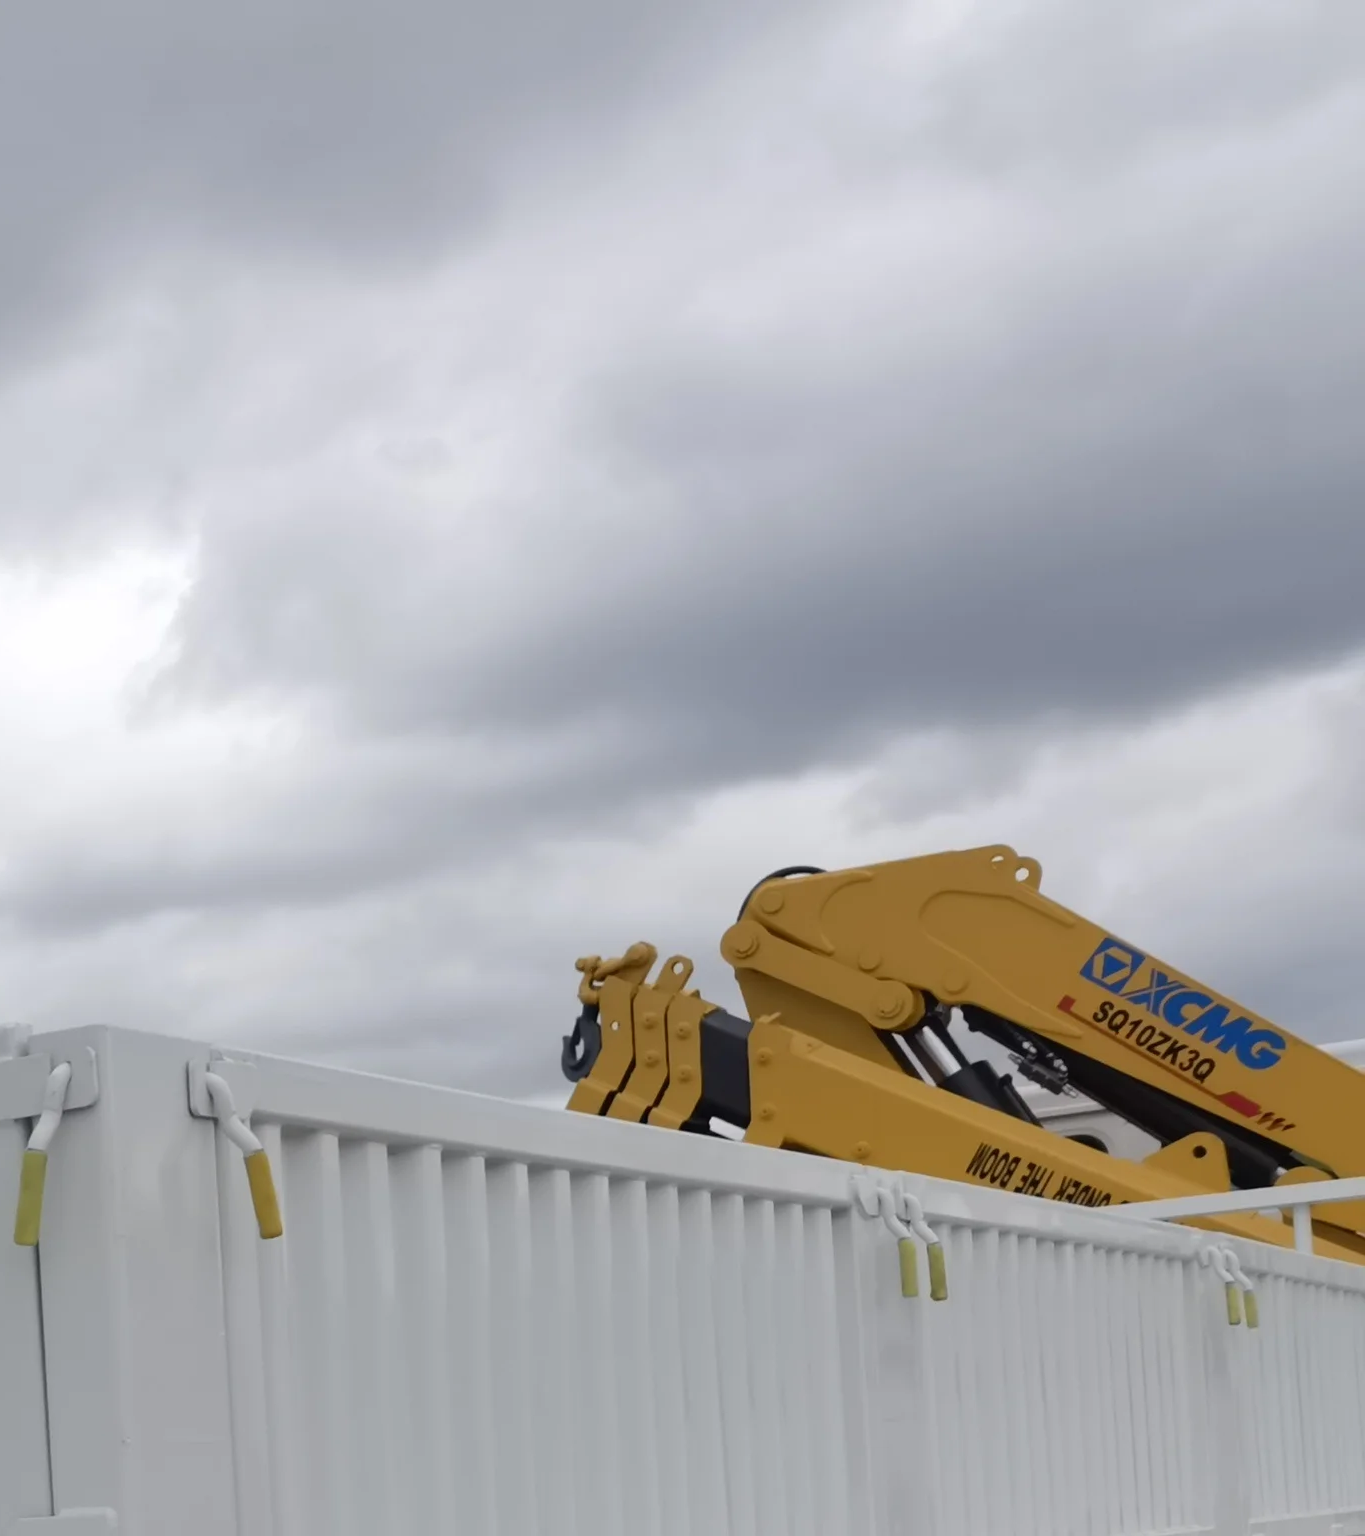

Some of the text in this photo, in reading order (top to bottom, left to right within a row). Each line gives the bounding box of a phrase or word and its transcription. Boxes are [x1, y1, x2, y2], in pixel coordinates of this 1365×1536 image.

[1092, 1000, 1216, 1084] SQ10ZK3Q
[1121, 968, 1287, 1070] XCMG
[966, 1143, 1021, 1189] BOOM
[1014, 1162, 1054, 1198] THE
